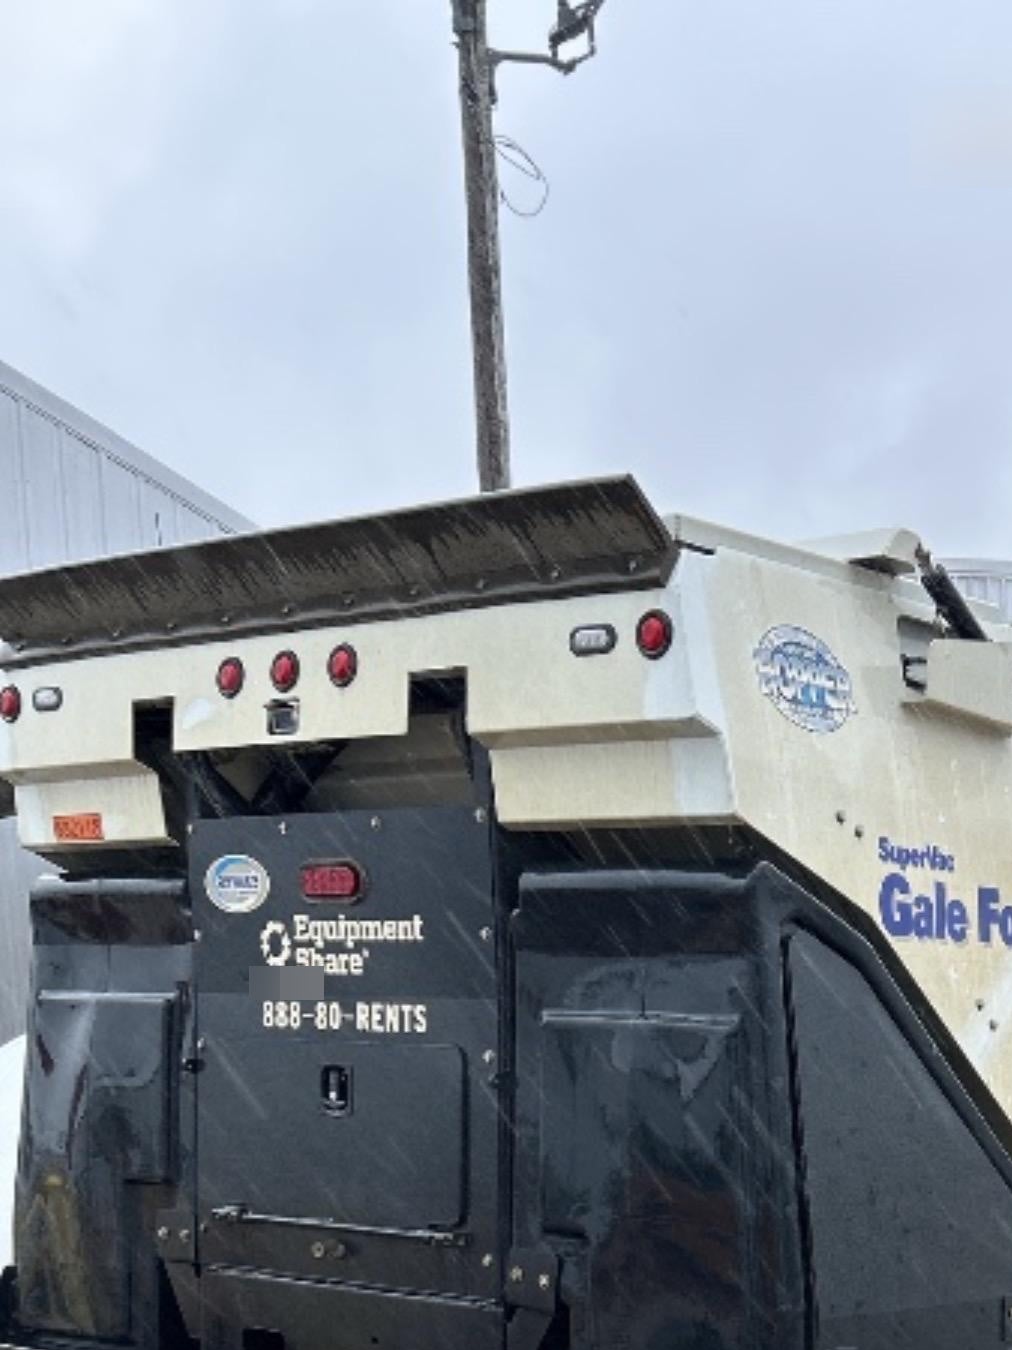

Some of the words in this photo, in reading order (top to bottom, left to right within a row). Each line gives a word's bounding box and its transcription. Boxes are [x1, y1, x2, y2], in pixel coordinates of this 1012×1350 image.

[879, 873, 967, 942] Gale
[293, 915, 424, 948] Equipment
[262, 1001, 427, 1032] 888-80-RENTS
